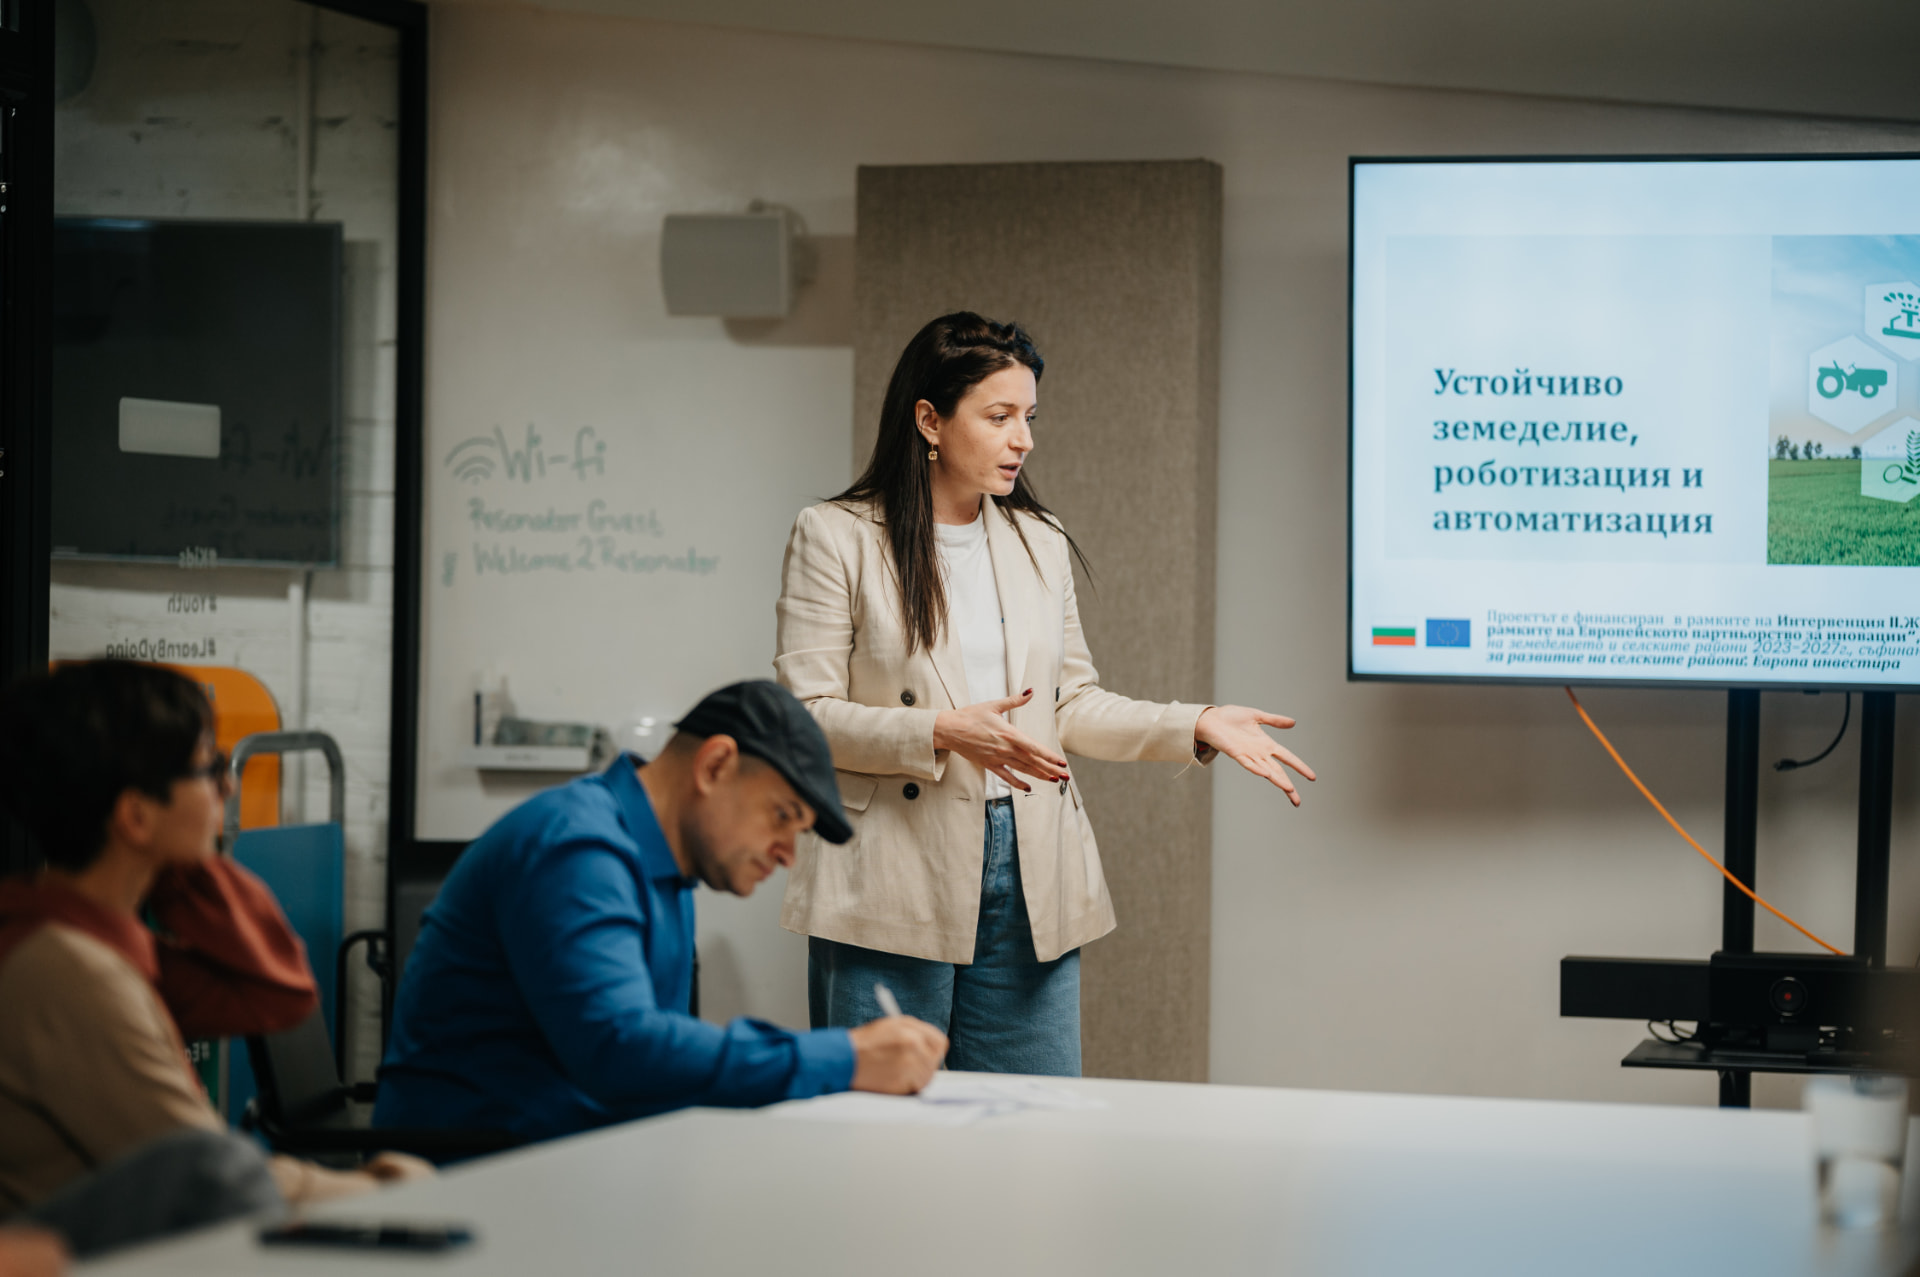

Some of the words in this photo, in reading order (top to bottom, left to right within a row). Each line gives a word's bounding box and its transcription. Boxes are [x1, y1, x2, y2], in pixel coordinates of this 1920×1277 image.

[1433, 367, 1624, 397] Устойчиво
[1433, 419, 1639, 447] земеделие,
[1433, 458, 1671, 493] роботизация
[1682, 467, 1704, 488] и
[1433, 509, 1713, 538] автоматизация
[1487, 609, 1557, 624] Проектът
[1561, 614, 1568, 623] е
[1573, 611, 1664, 627] финансиран
[1675, 616, 1682, 625] в
[1687, 615, 1750, 629] рамките
[1755, 617, 1772, 626] на
[1777, 615, 1885, 630] Интервенция
[1487, 625, 1552, 638] рамките
[1557, 627, 1574, 636] на
[1579, 625, 1688, 640] Европейското
[1692, 629, 1802, 642] партньорство
[1806, 632, 1823, 641] за
[1487, 638, 1504, 650] на
[1508, 636, 1604, 651] земеделието
[1609, 642, 1618, 651] и
[1622, 641, 1691, 653] селските
[1694, 640, 1748, 655] райони
[1486, 651, 1504, 662] за
[1507, 651, 1584, 664] развитие
[1588, 653, 1606, 664] на
[1610, 653, 1685, 666] селските
[1753, 655, 1808, 670] Европа
[1812, 658, 1901, 673] инвестира
